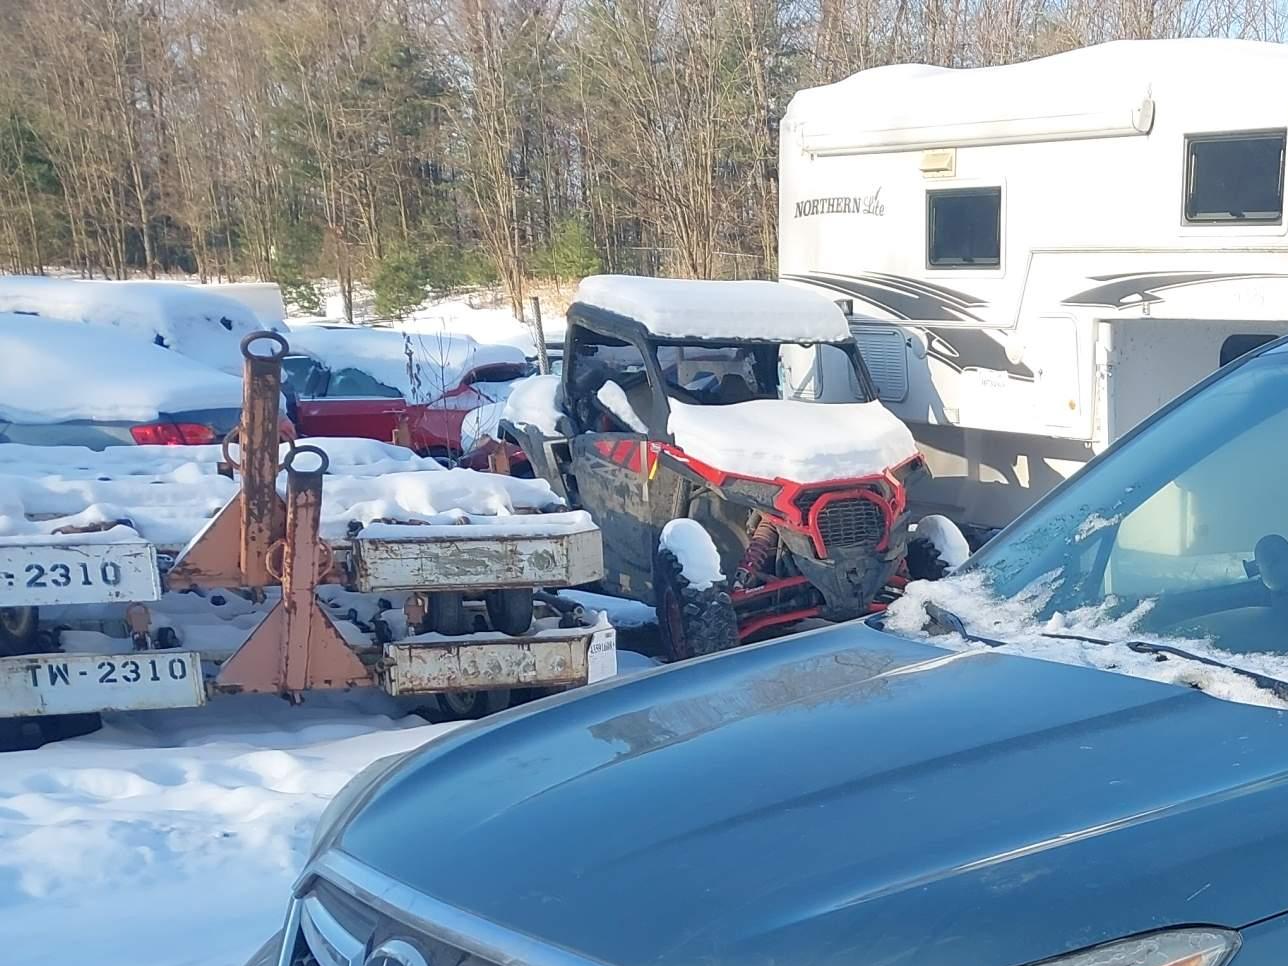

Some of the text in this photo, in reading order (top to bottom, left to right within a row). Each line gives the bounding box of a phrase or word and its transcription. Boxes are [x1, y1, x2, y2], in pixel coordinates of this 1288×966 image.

[793, 186, 885, 218] NORTHERN Lite
[27, 657, 188, 688] TW-2310
